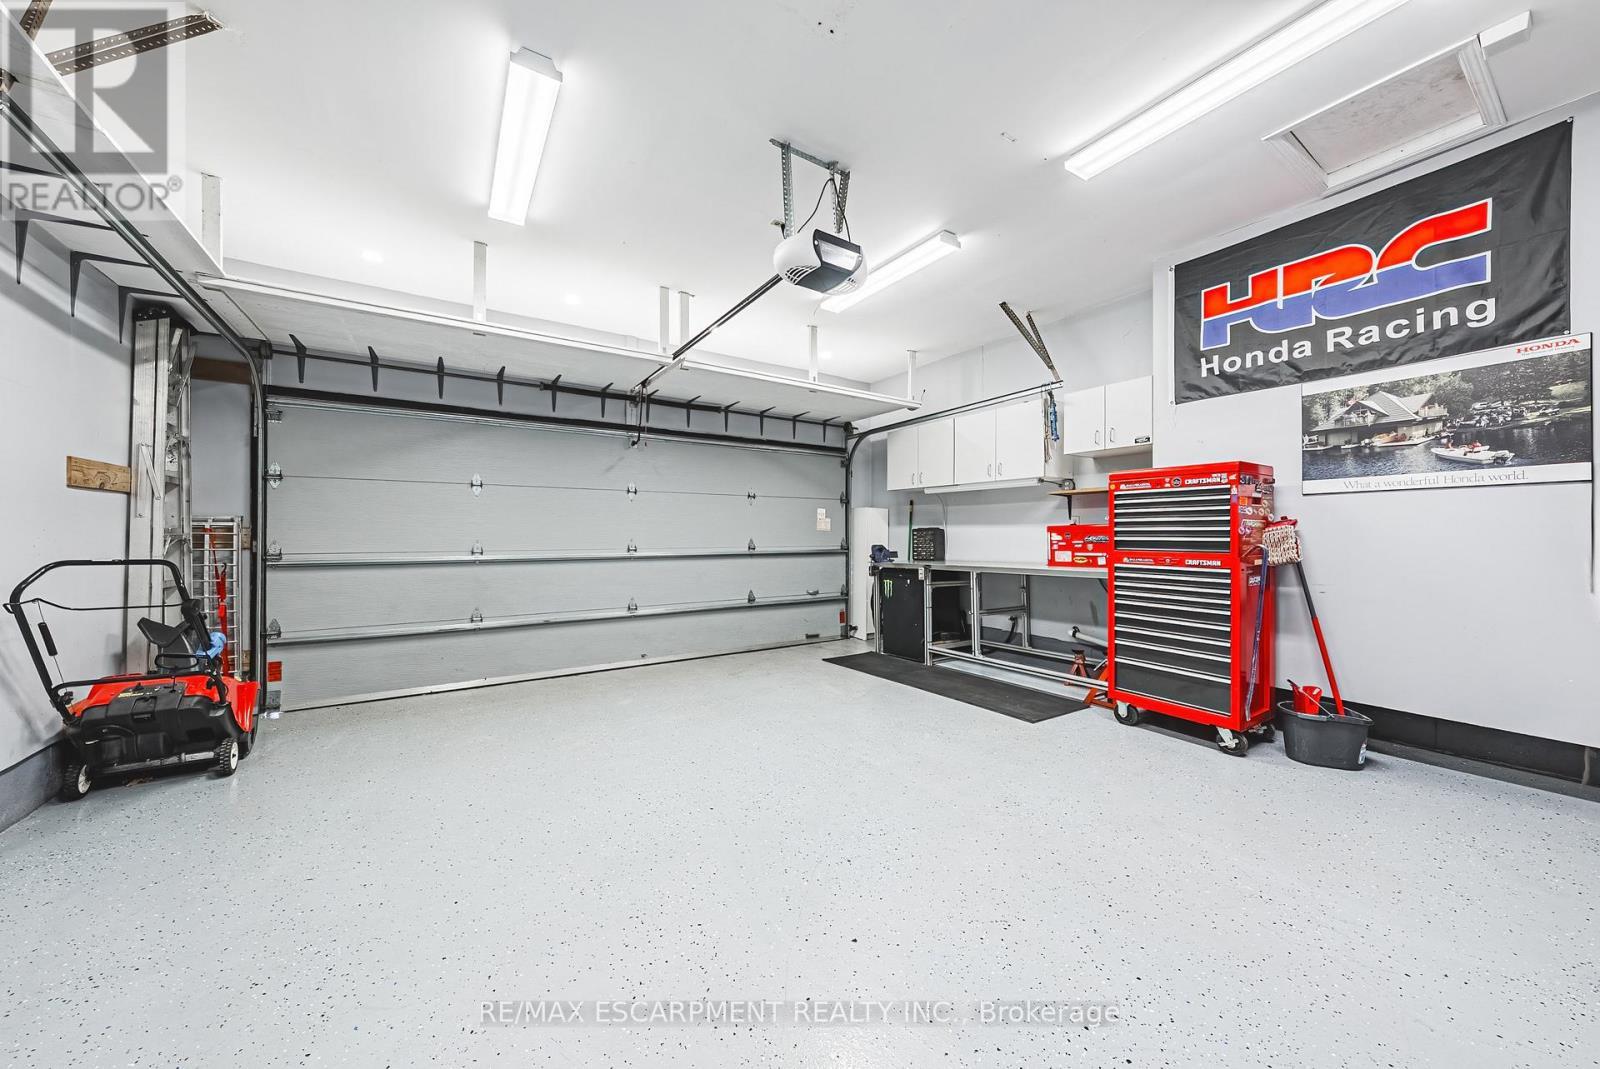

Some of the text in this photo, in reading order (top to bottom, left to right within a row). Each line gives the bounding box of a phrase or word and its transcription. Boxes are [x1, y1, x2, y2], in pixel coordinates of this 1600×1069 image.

[1201, 198, 1493, 350] HRC
[1200, 298, 1496, 378] Honda Racing
[1516, 338, 1580, 354] HONDA
[1184, 477, 1221, 485] CRAFTSMAN
[1343, 479, 1371, 489] What
[1384, 475, 1439, 487] wonderful
[1444, 473, 1485, 484] Honda
[1488, 470, 1528, 481] world.
